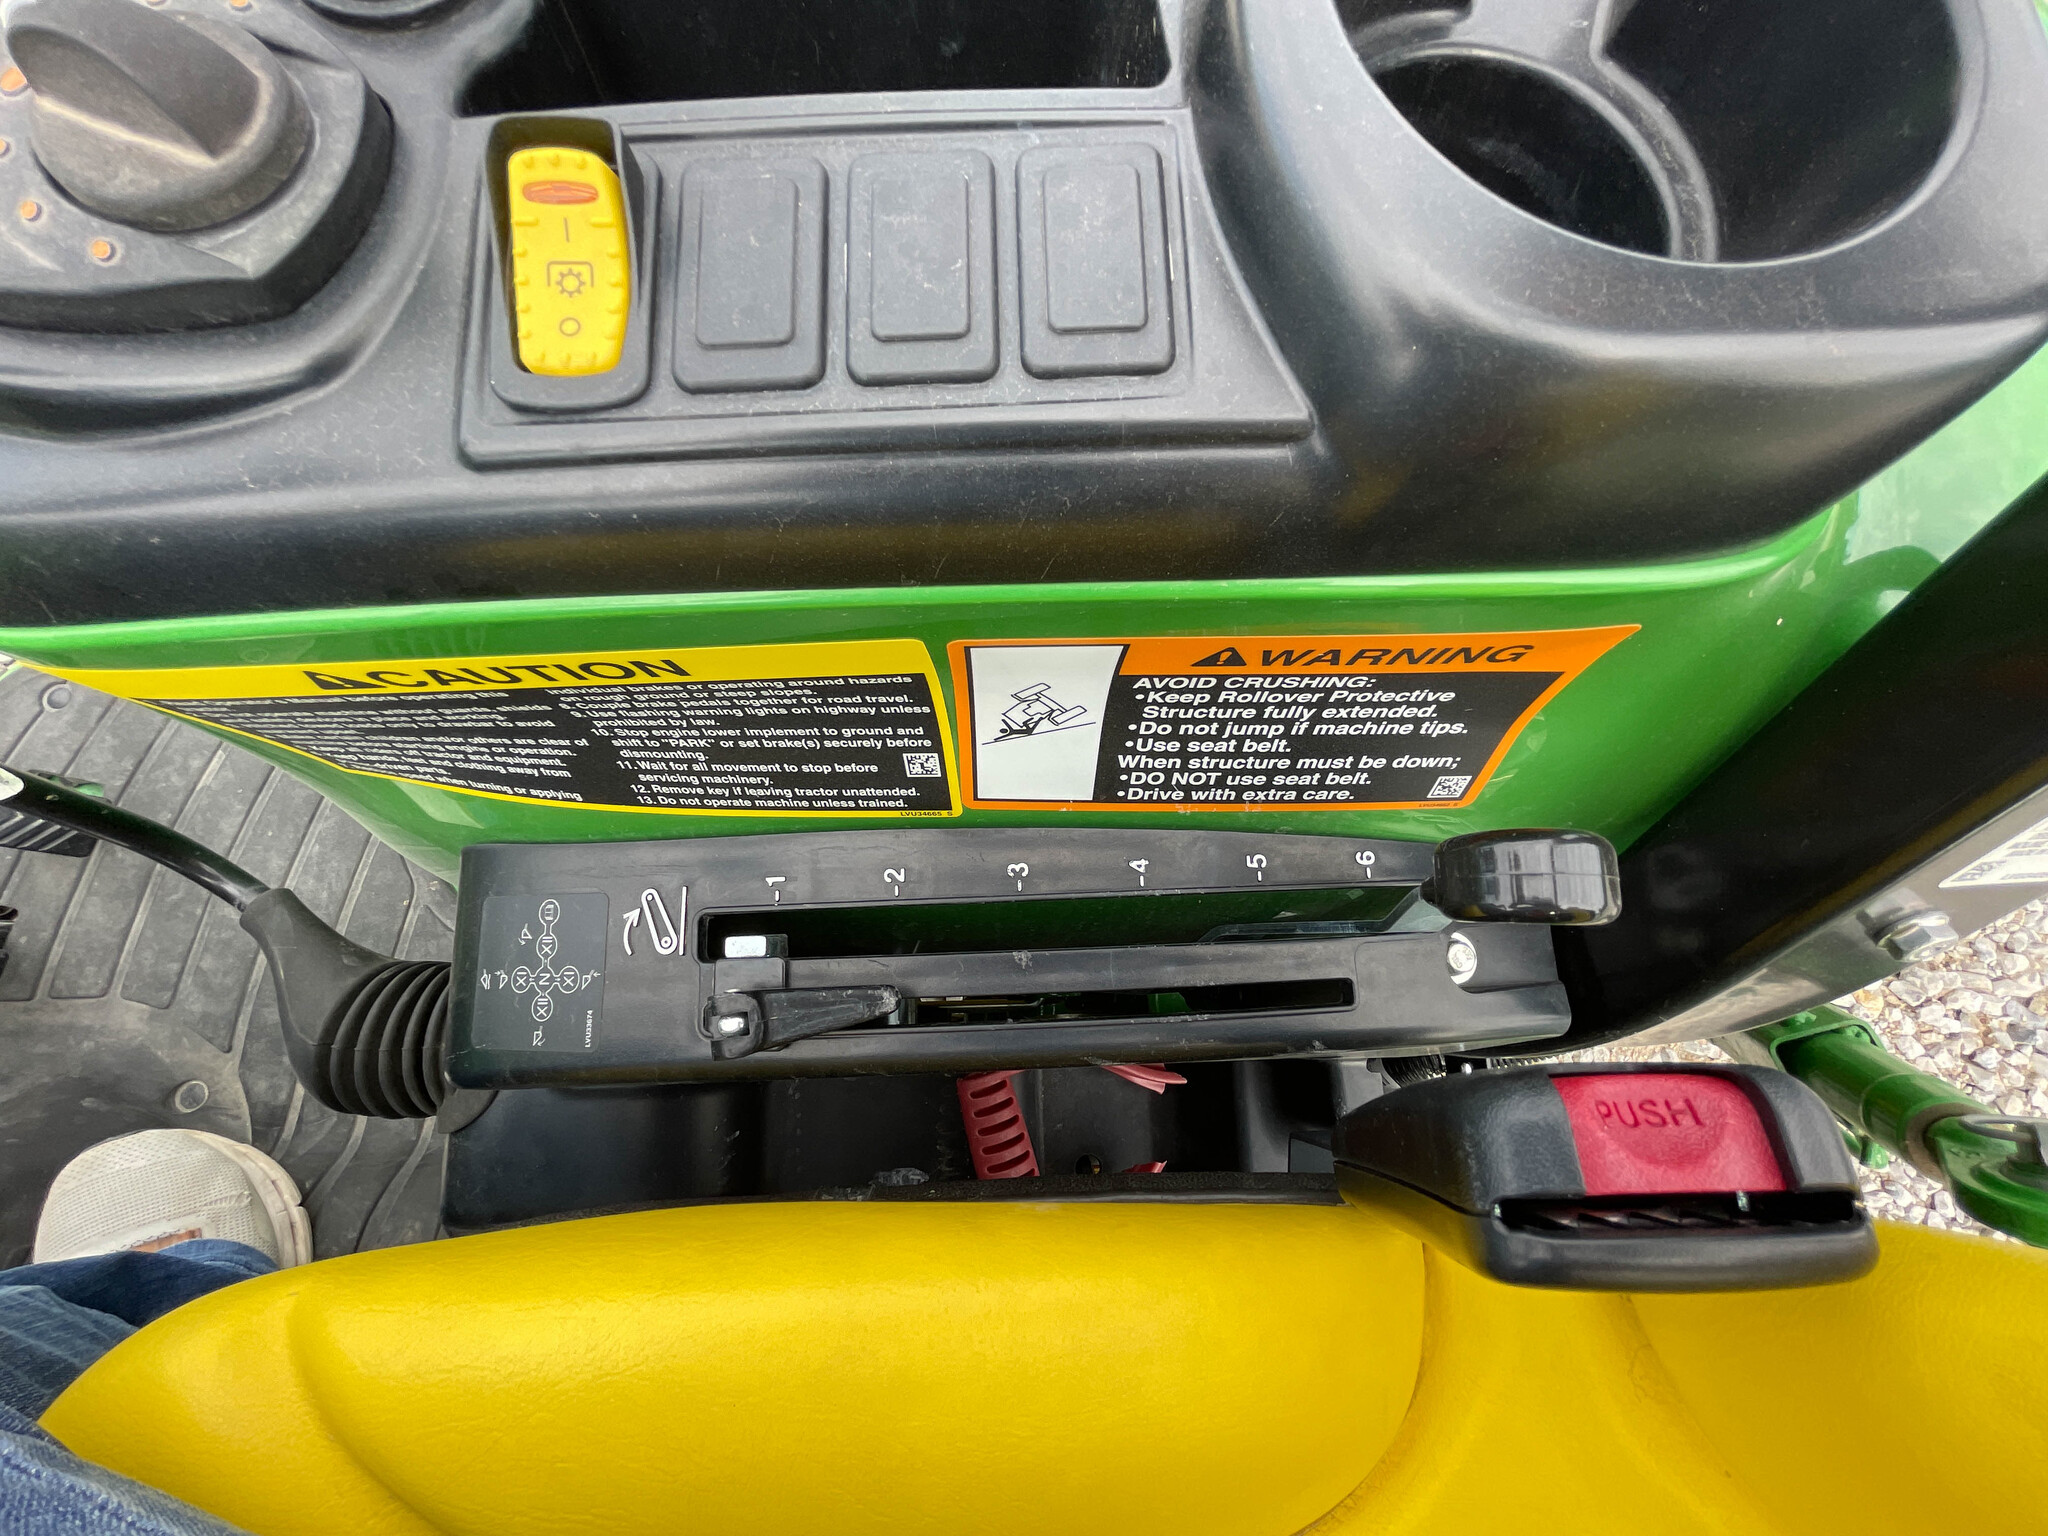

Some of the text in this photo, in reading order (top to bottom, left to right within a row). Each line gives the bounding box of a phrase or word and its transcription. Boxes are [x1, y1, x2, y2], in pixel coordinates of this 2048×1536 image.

[1261, 645, 1535, 667] WARNING
[366, 659, 691, 687] CAUTION
[626, 683, 683, 693] brakes
[686, 683, 703, 691] or
[707, 680, 785, 690] operating
[787, 678, 845, 687] around
[848, 676, 912, 685] hazards
[1132, 676, 1377, 689] AVOID CRUSHING:
[476, 690, 509, 698] this
[583, 693, 631, 702] rough
[633, 691, 689, 701] ground
[713, 690, 757, 699] steep
[760, 688, 817, 697] slopes.
[1218, 690, 1325, 703] Rollover
[1328, 689, 1456, 703] Protective
[496, 704, 552, 713] shields
[575, 701, 632, 711] Couple
[634, 699, 678, 708] brake
[679, 698, 731, 708] pedals
[733, 696, 798, 707] together
[801, 696, 823, 704] for
[827, 695, 862, 704] road
[865, 694, 914, 703] travel.
[586, 709, 618, 718] Use
[618, 708, 681, 719] flashing
[682, 706, 743, 718] warning
[744, 706, 788, 717] lights
[814, 705, 876, 716] highway
[880, 704, 931, 714] unless
[1142, 705, 1438, 722] Structure fully extended.
[515, 719, 555, 727] avoid
[593, 717, 721, 728] prohibited by law.
[1178, 722, 1219, 735] not
[1221, 721, 1285, 739] jump
[1290, 721, 1311, 735] if
[1312, 721, 1414, 735] machine
[1419, 720, 1469, 738] tips.
[590, 726, 924, 739] 10. Stop engine lower implement to ground and
[467, 736, 512, 745] others
[537, 737, 571, 747] clear
[574, 738, 589, 747] of
[611, 738, 644, 747] shift
[645, 739, 660, 747] to
[661, 738, 715, 748] "PARK"
[738, 739, 759, 747] set
[762, 738, 821, 750] brake(s)
[823, 738, 883, 749] securely
[886, 737, 932, 747] before
[1186, 739, 1237, 752] seat
[1241, 739, 1291, 752] belt.
[445, 744, 489, 753] engine
[508, 745, 577, 756] operation.
[619, 749, 709, 761] dismounting.
[421, 750, 465, 760] tractor
[468, 753, 493, 761] and
[494, 754, 566, 767] equipment.
[1117, 754, 1461, 770] When structure must be down;
[415, 764, 451, 775] parts.
[428, 758, 453, 767] and
[454, 759, 507, 774] clothing
[507, 765, 539, 777] away
[539, 767, 572, 778] from
[616, 760, 879, 774] 11. Wait for all movement to stop before
[637, 773, 774, 786] servicing machinery.
[1171, 772, 1222, 786] NOT
[1226, 775, 1267, 785] use
[1272, 772, 1321, 785] seat
[1324, 772, 1372, 785] belt.
[435, 775, 583, 802] when turning or applying
[630, 784, 921, 798] 12. Remove key if leaving tractor unattended.
[1191, 787, 1240, 800] with
[1242, 789, 1297, 801] extra
[1302, 790, 1355, 801] care.
[637, 795, 908, 808] 13. Do not operate machine unless trained.
[1594, 1098, 1706, 1128] PUSH
